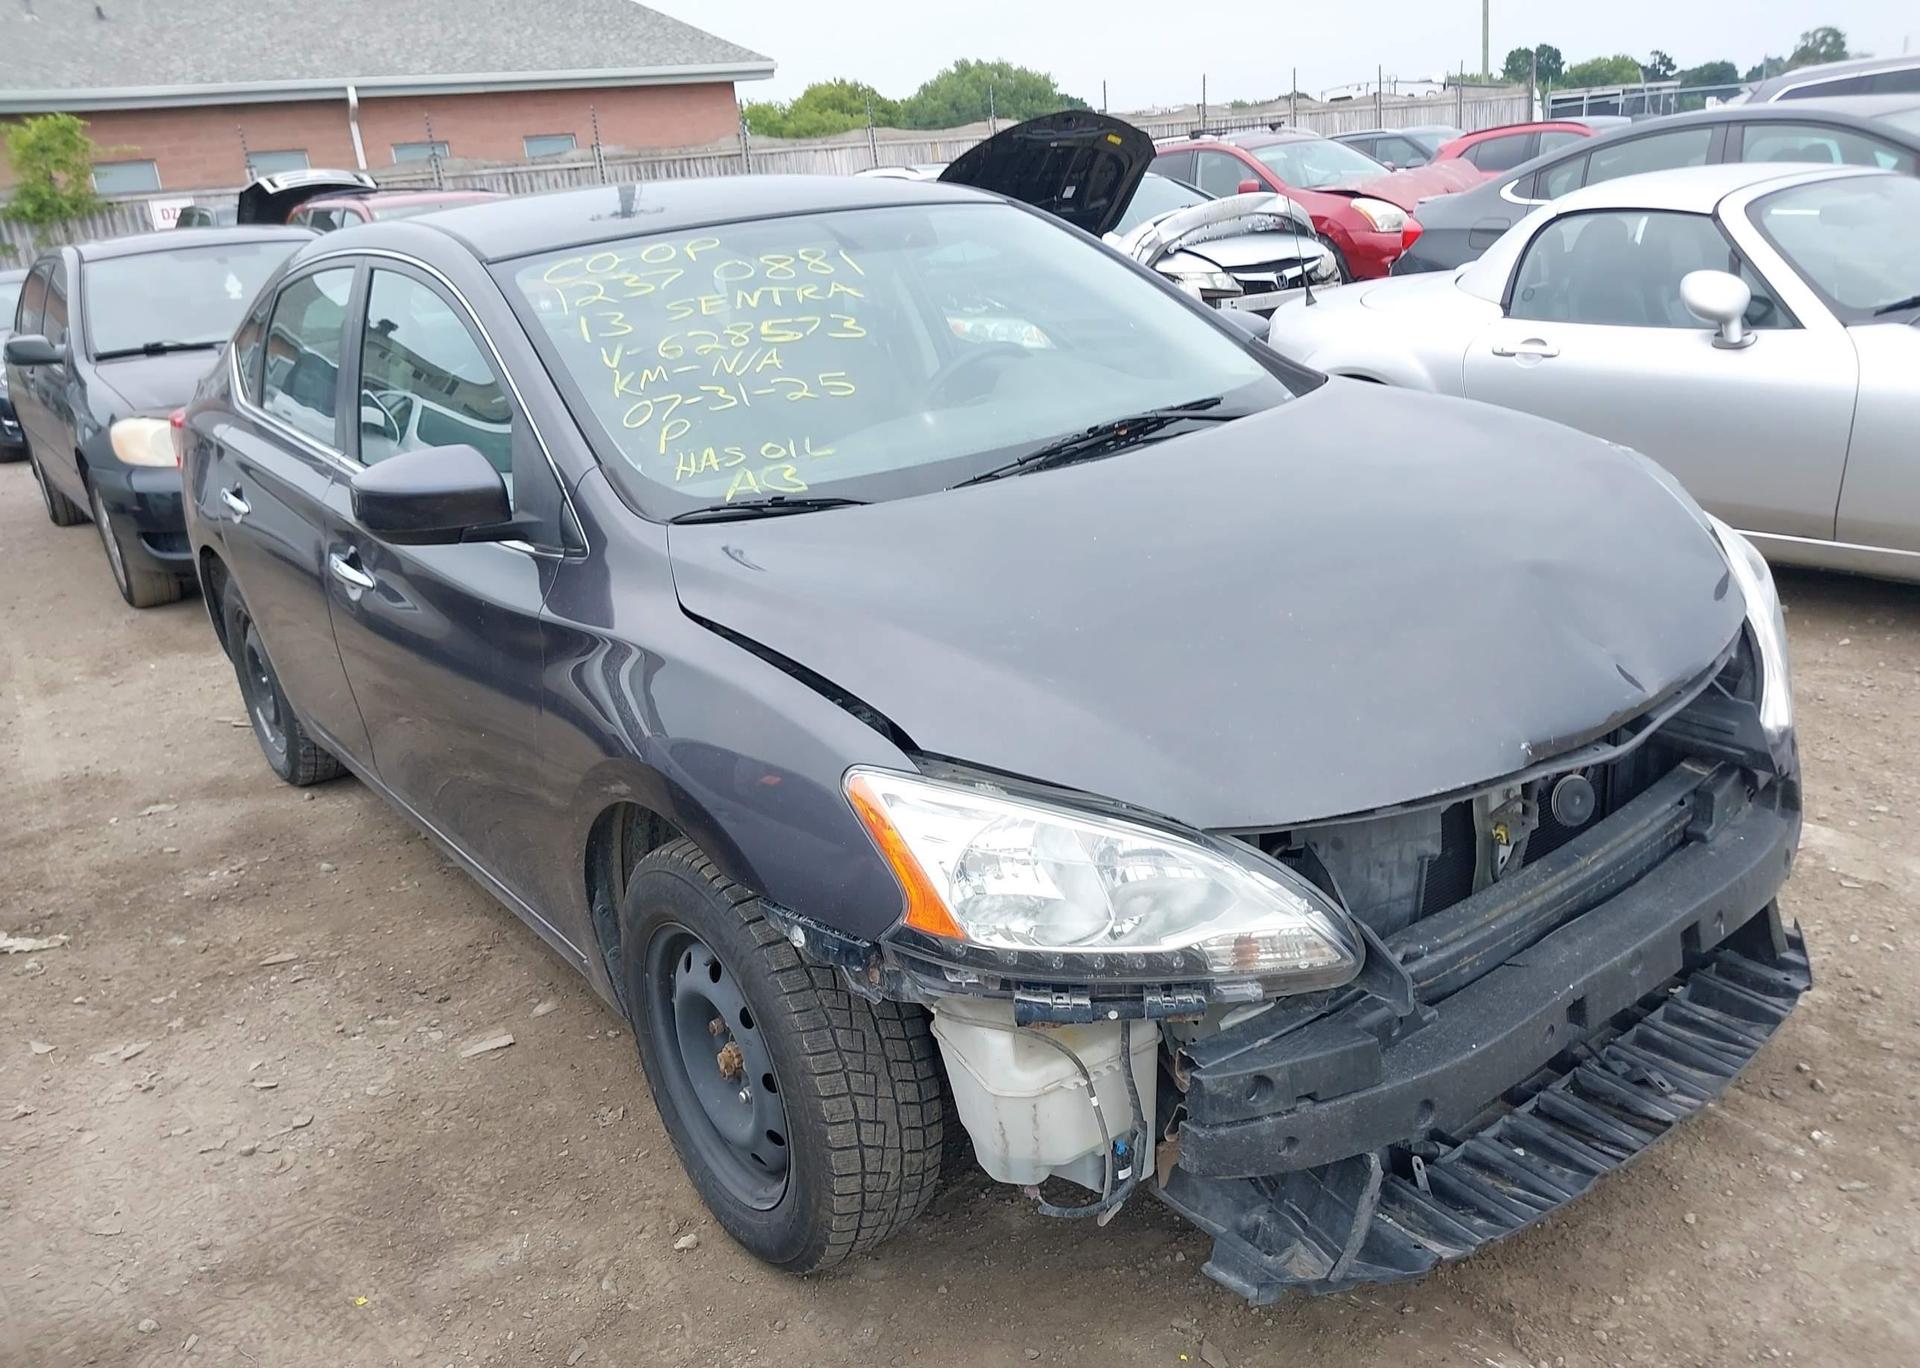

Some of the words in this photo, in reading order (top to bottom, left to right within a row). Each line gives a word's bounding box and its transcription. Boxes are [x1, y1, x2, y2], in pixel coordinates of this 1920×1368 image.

[556, 268, 684, 315] 1237
[713, 248, 865, 282] 0881
[580, 312, 633, 343] 13
[665, 281, 865, 321] SENTRA
[622, 371, 856, 429] 07-31-25
[659, 418, 692, 455] P
[675, 446, 747, 481] HAS
[760, 436, 838, 459] OIL
